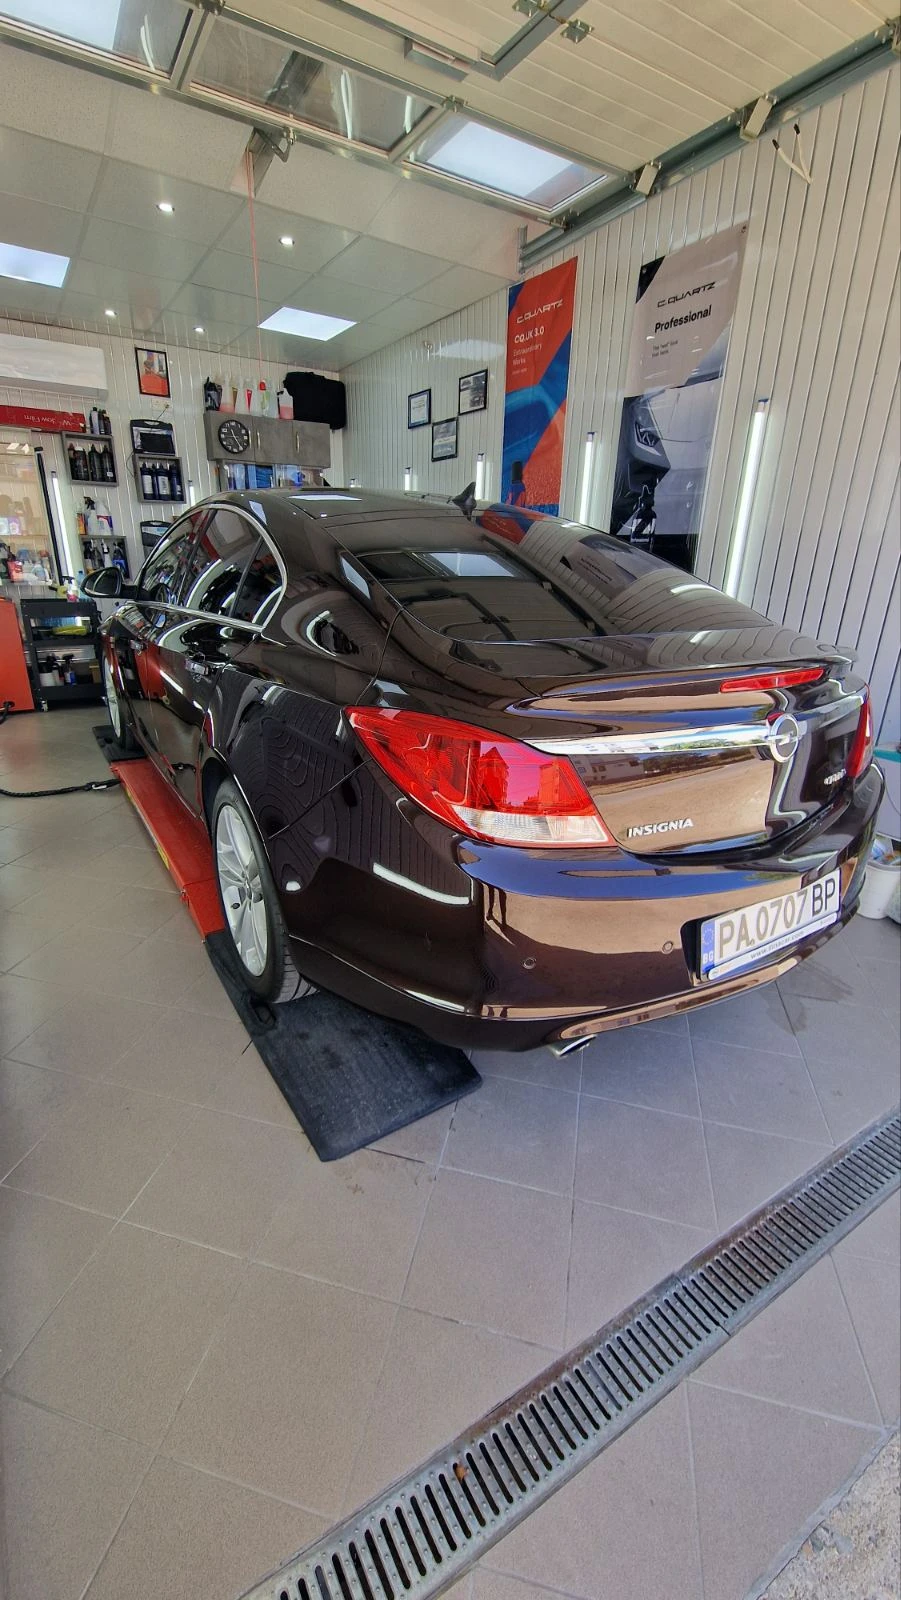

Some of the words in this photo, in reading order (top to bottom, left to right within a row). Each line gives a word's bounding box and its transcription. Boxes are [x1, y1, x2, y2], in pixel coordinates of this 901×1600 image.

[654, 304, 712, 333] Professional
[534, 325, 545, 337] 3.0
[627, 818, 694, 839] INSIGNIA
[702, 951, 714, 965] BG
